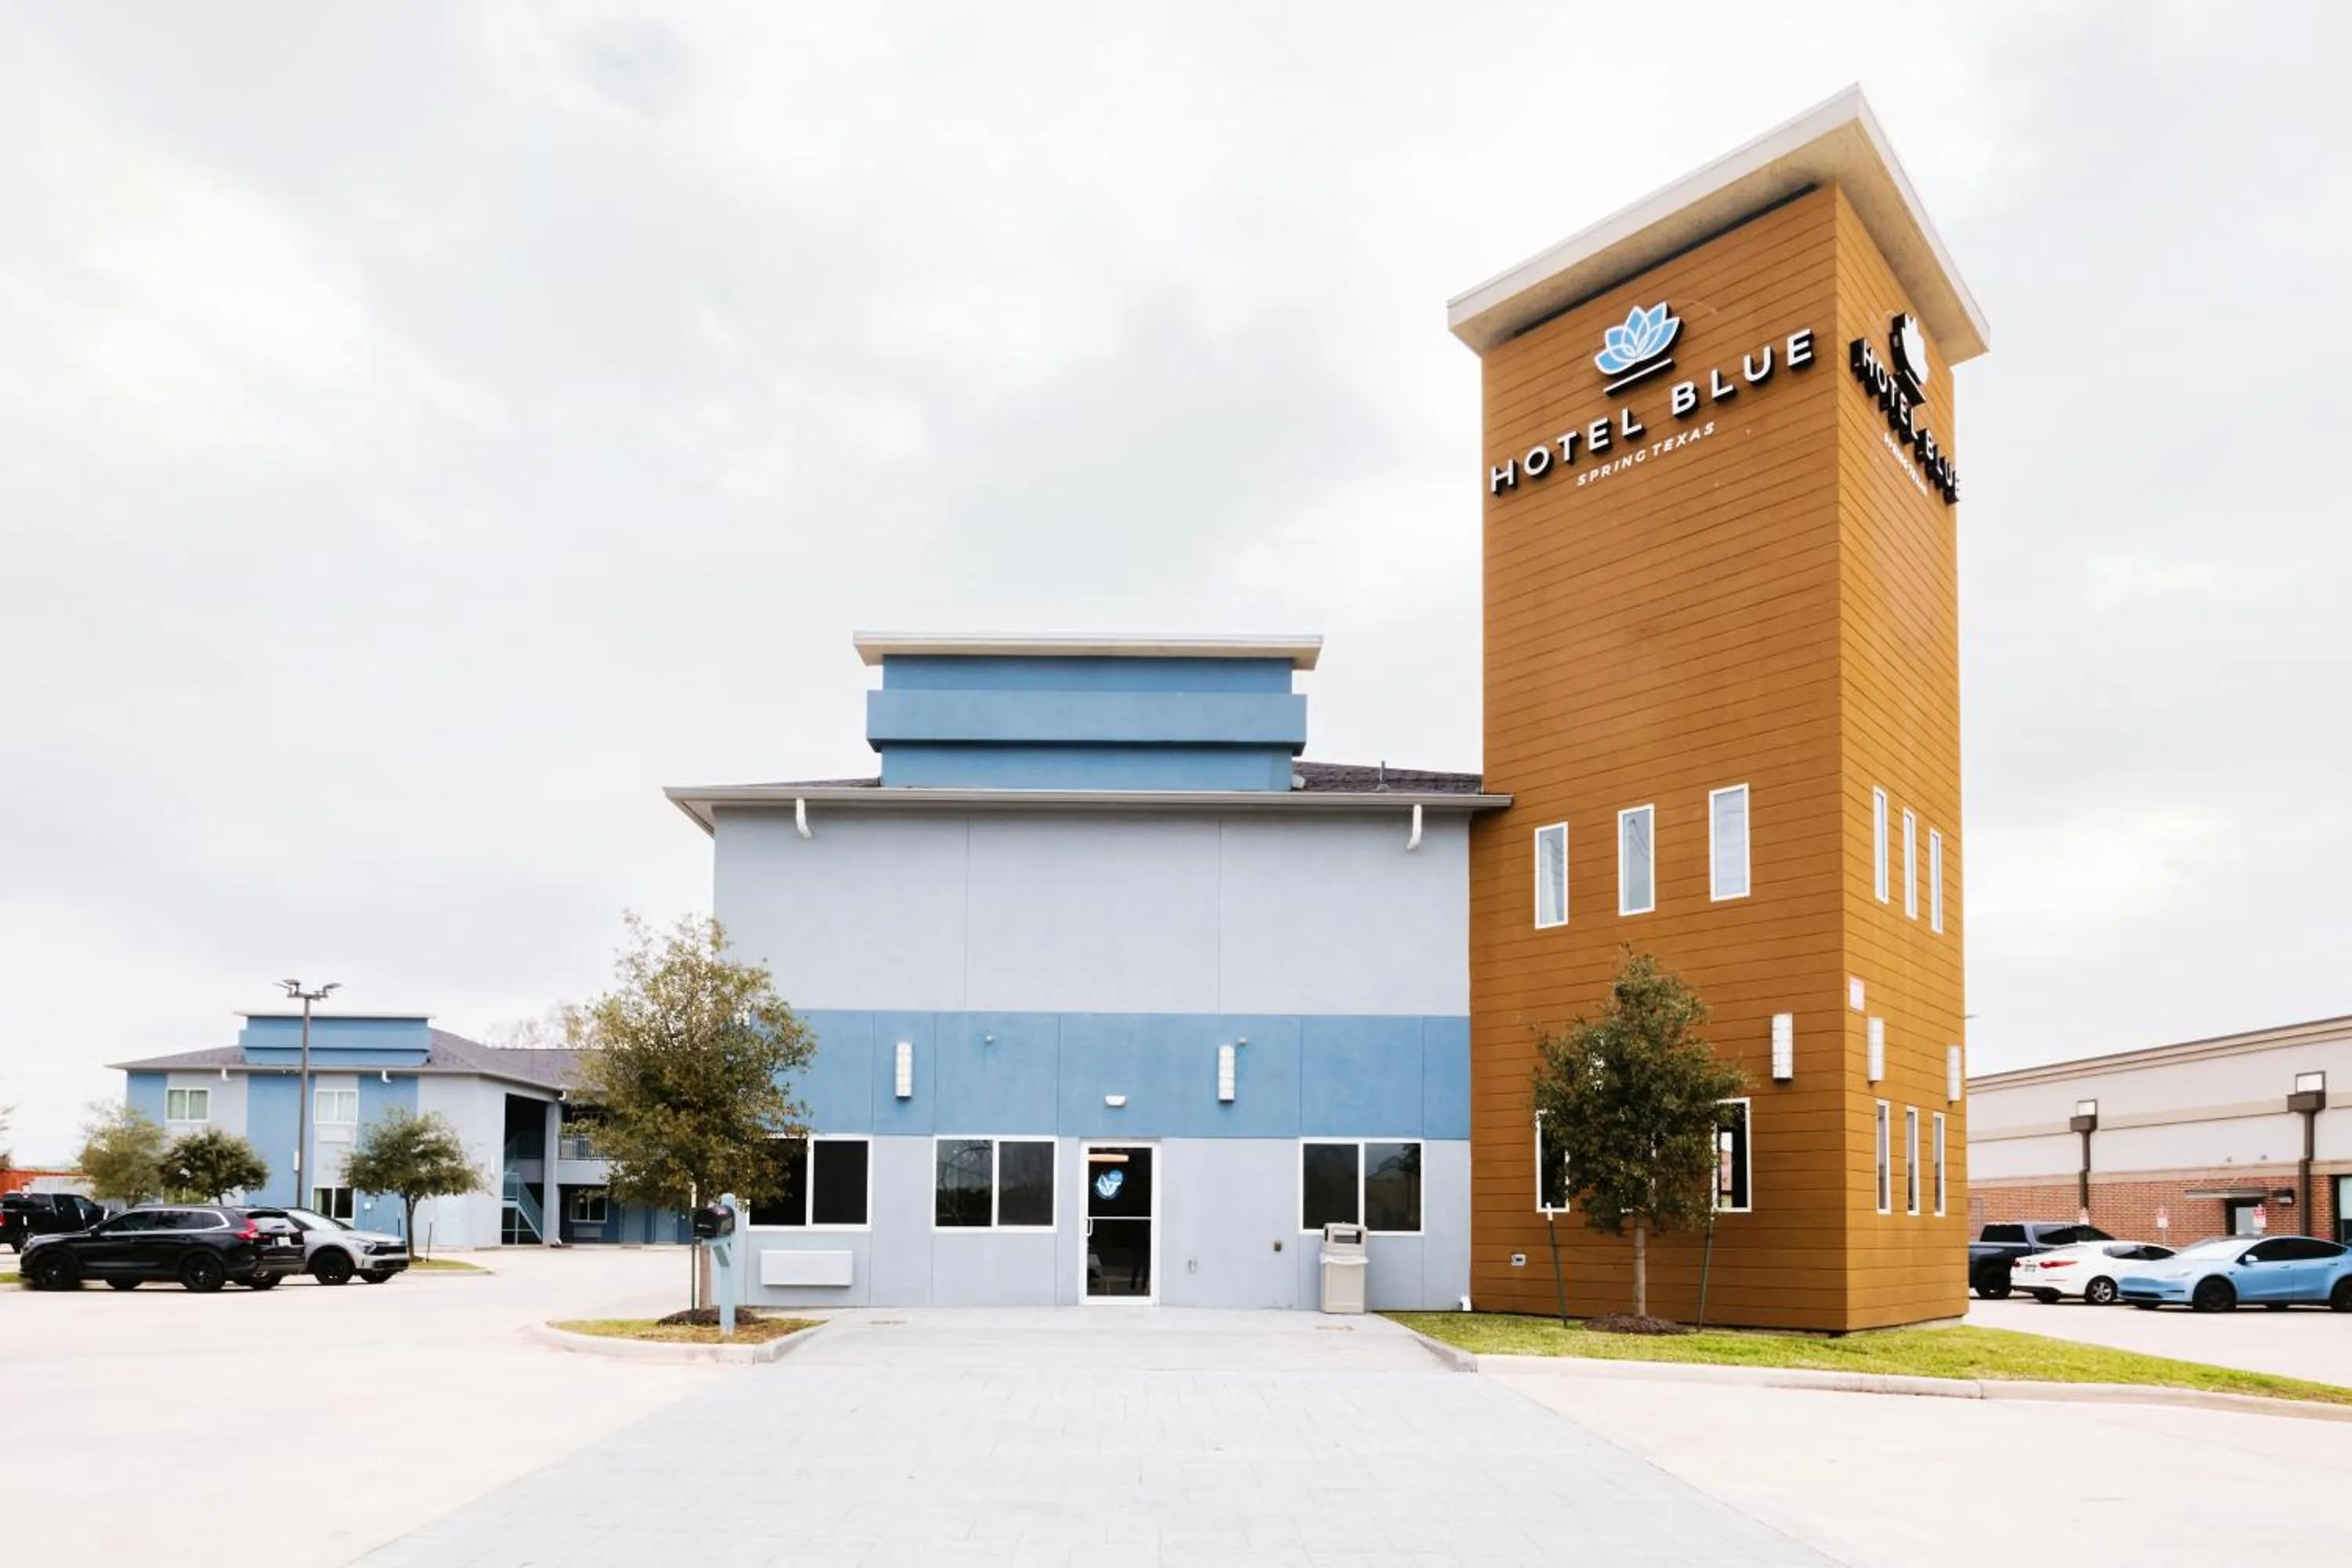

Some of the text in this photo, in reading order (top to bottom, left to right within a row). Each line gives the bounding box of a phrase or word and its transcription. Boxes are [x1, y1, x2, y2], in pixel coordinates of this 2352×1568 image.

[1490, 328, 1814, 494] HOTEL BLUE
[1858, 337, 1918, 440] HOTEL
[1577, 421, 1715, 486] SPRING TEXAS
